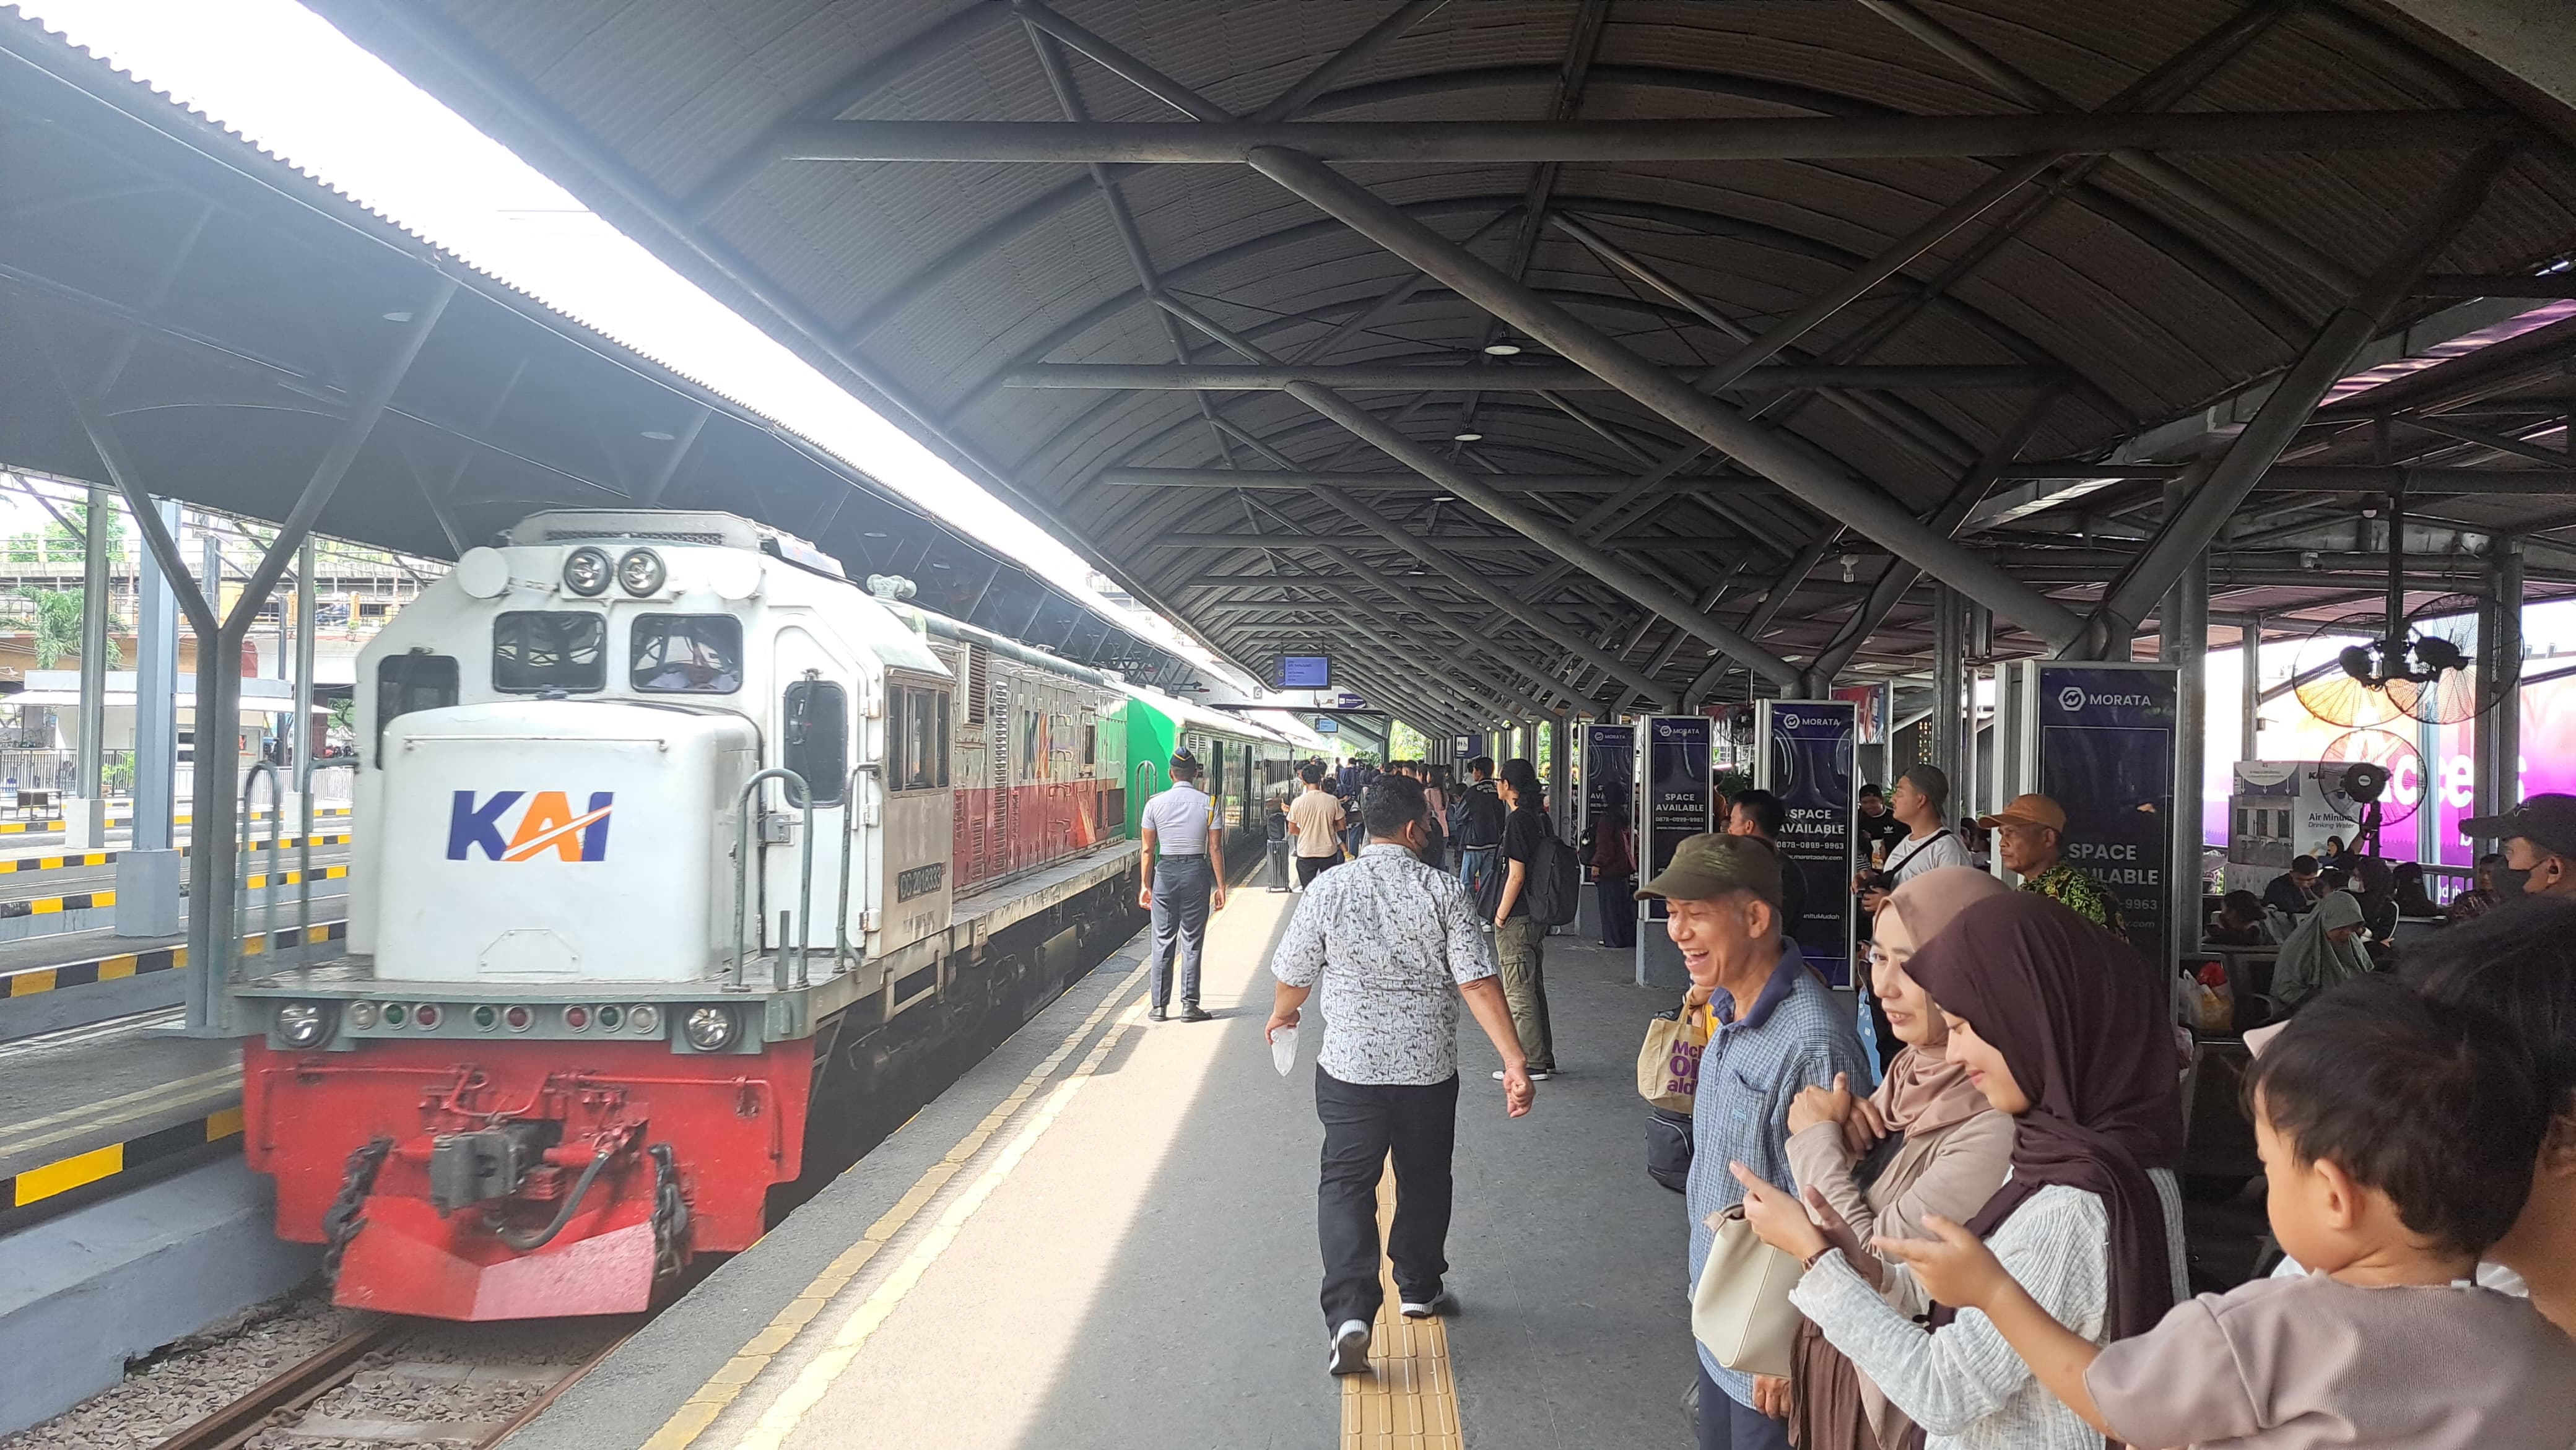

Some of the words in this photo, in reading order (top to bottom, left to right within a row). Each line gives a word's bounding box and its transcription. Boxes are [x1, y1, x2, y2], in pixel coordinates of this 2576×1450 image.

[2090, 694, 2151, 706] MORATA
[1664, 793, 1695, 801] SPACE
[1655, 804, 1705, 812] AVAILABLE
[1789, 809, 1831, 819] SPACE
[2308, 813, 2321, 821] Air
[447, 790, 616, 862] KAI
[1780, 823, 1845, 835] AVAILABLE
[2068, 843, 2137, 861] SPACE
